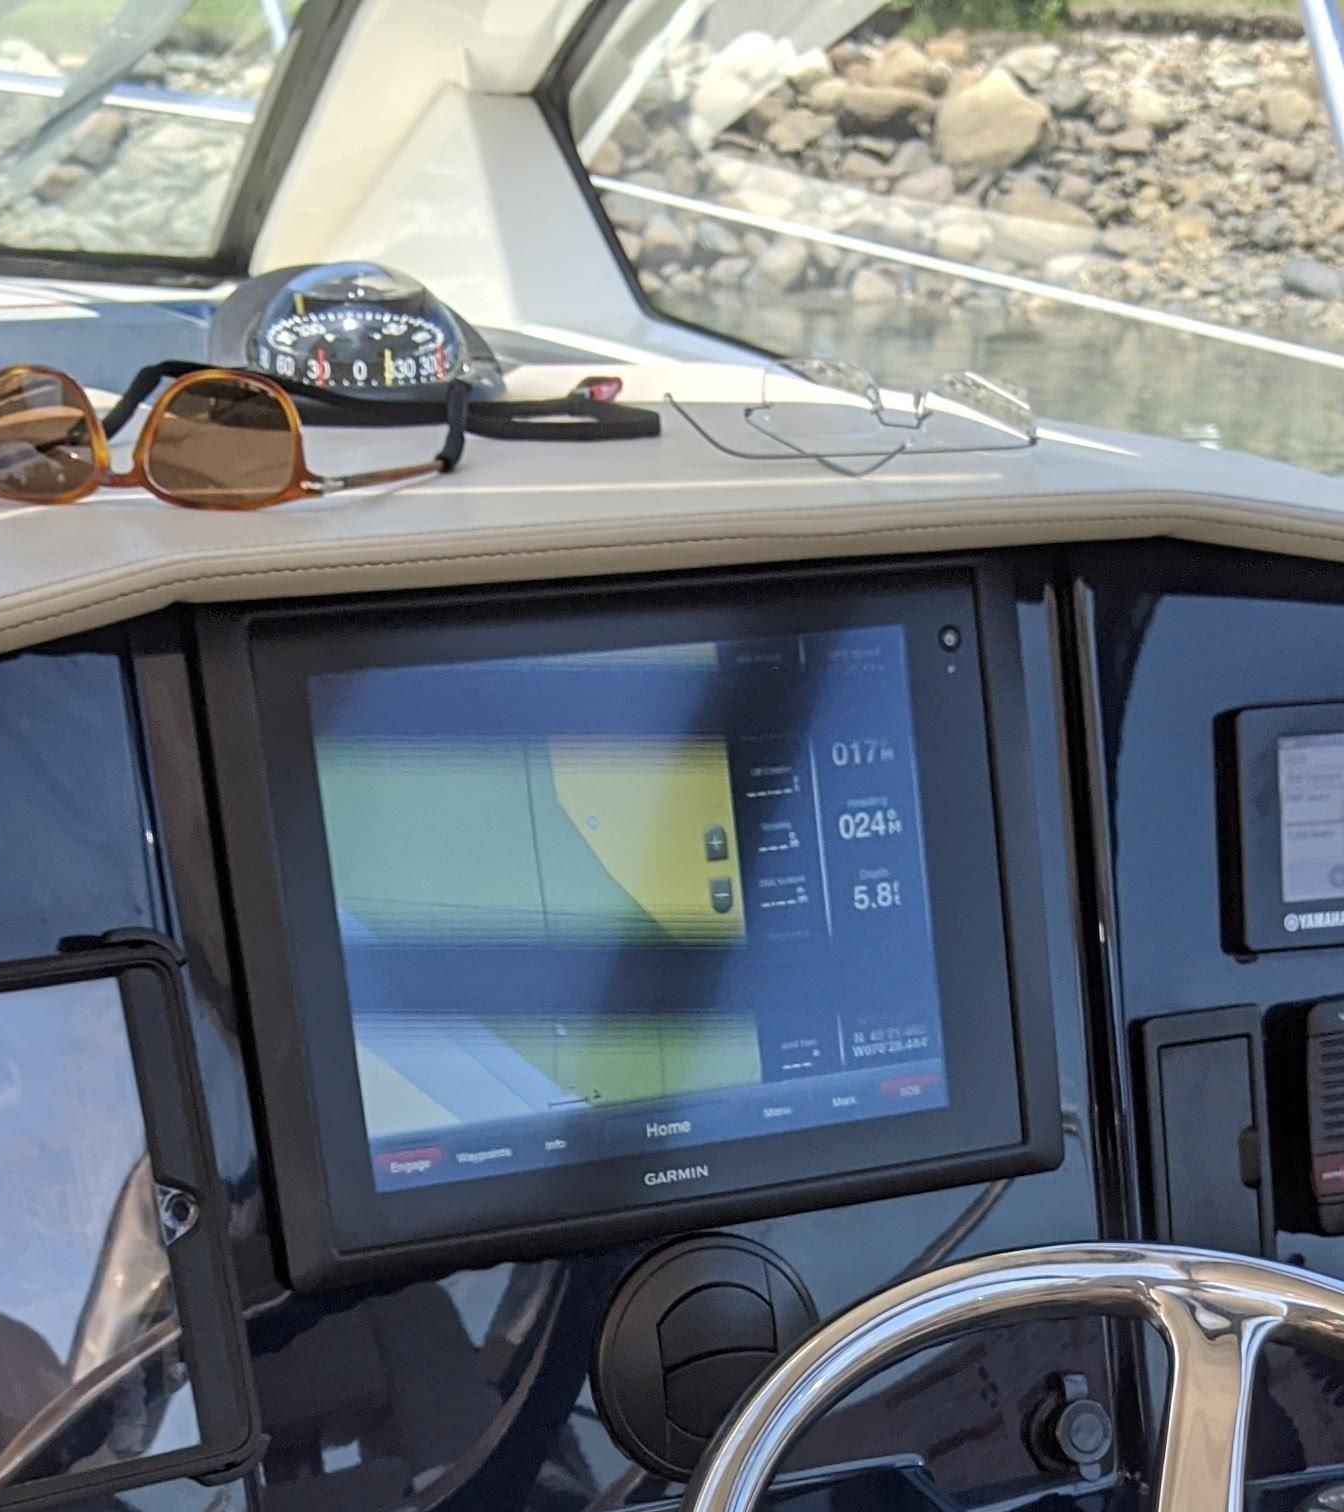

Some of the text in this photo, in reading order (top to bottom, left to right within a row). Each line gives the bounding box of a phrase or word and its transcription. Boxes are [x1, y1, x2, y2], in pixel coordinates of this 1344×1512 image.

[352, 358, 368, 381] 0
[831, 740, 878, 766] 017
[853, 881, 893, 910] 5.8
[645, 1120, 692, 1138] Home
[643, 1164, 710, 1186] GARMIN
